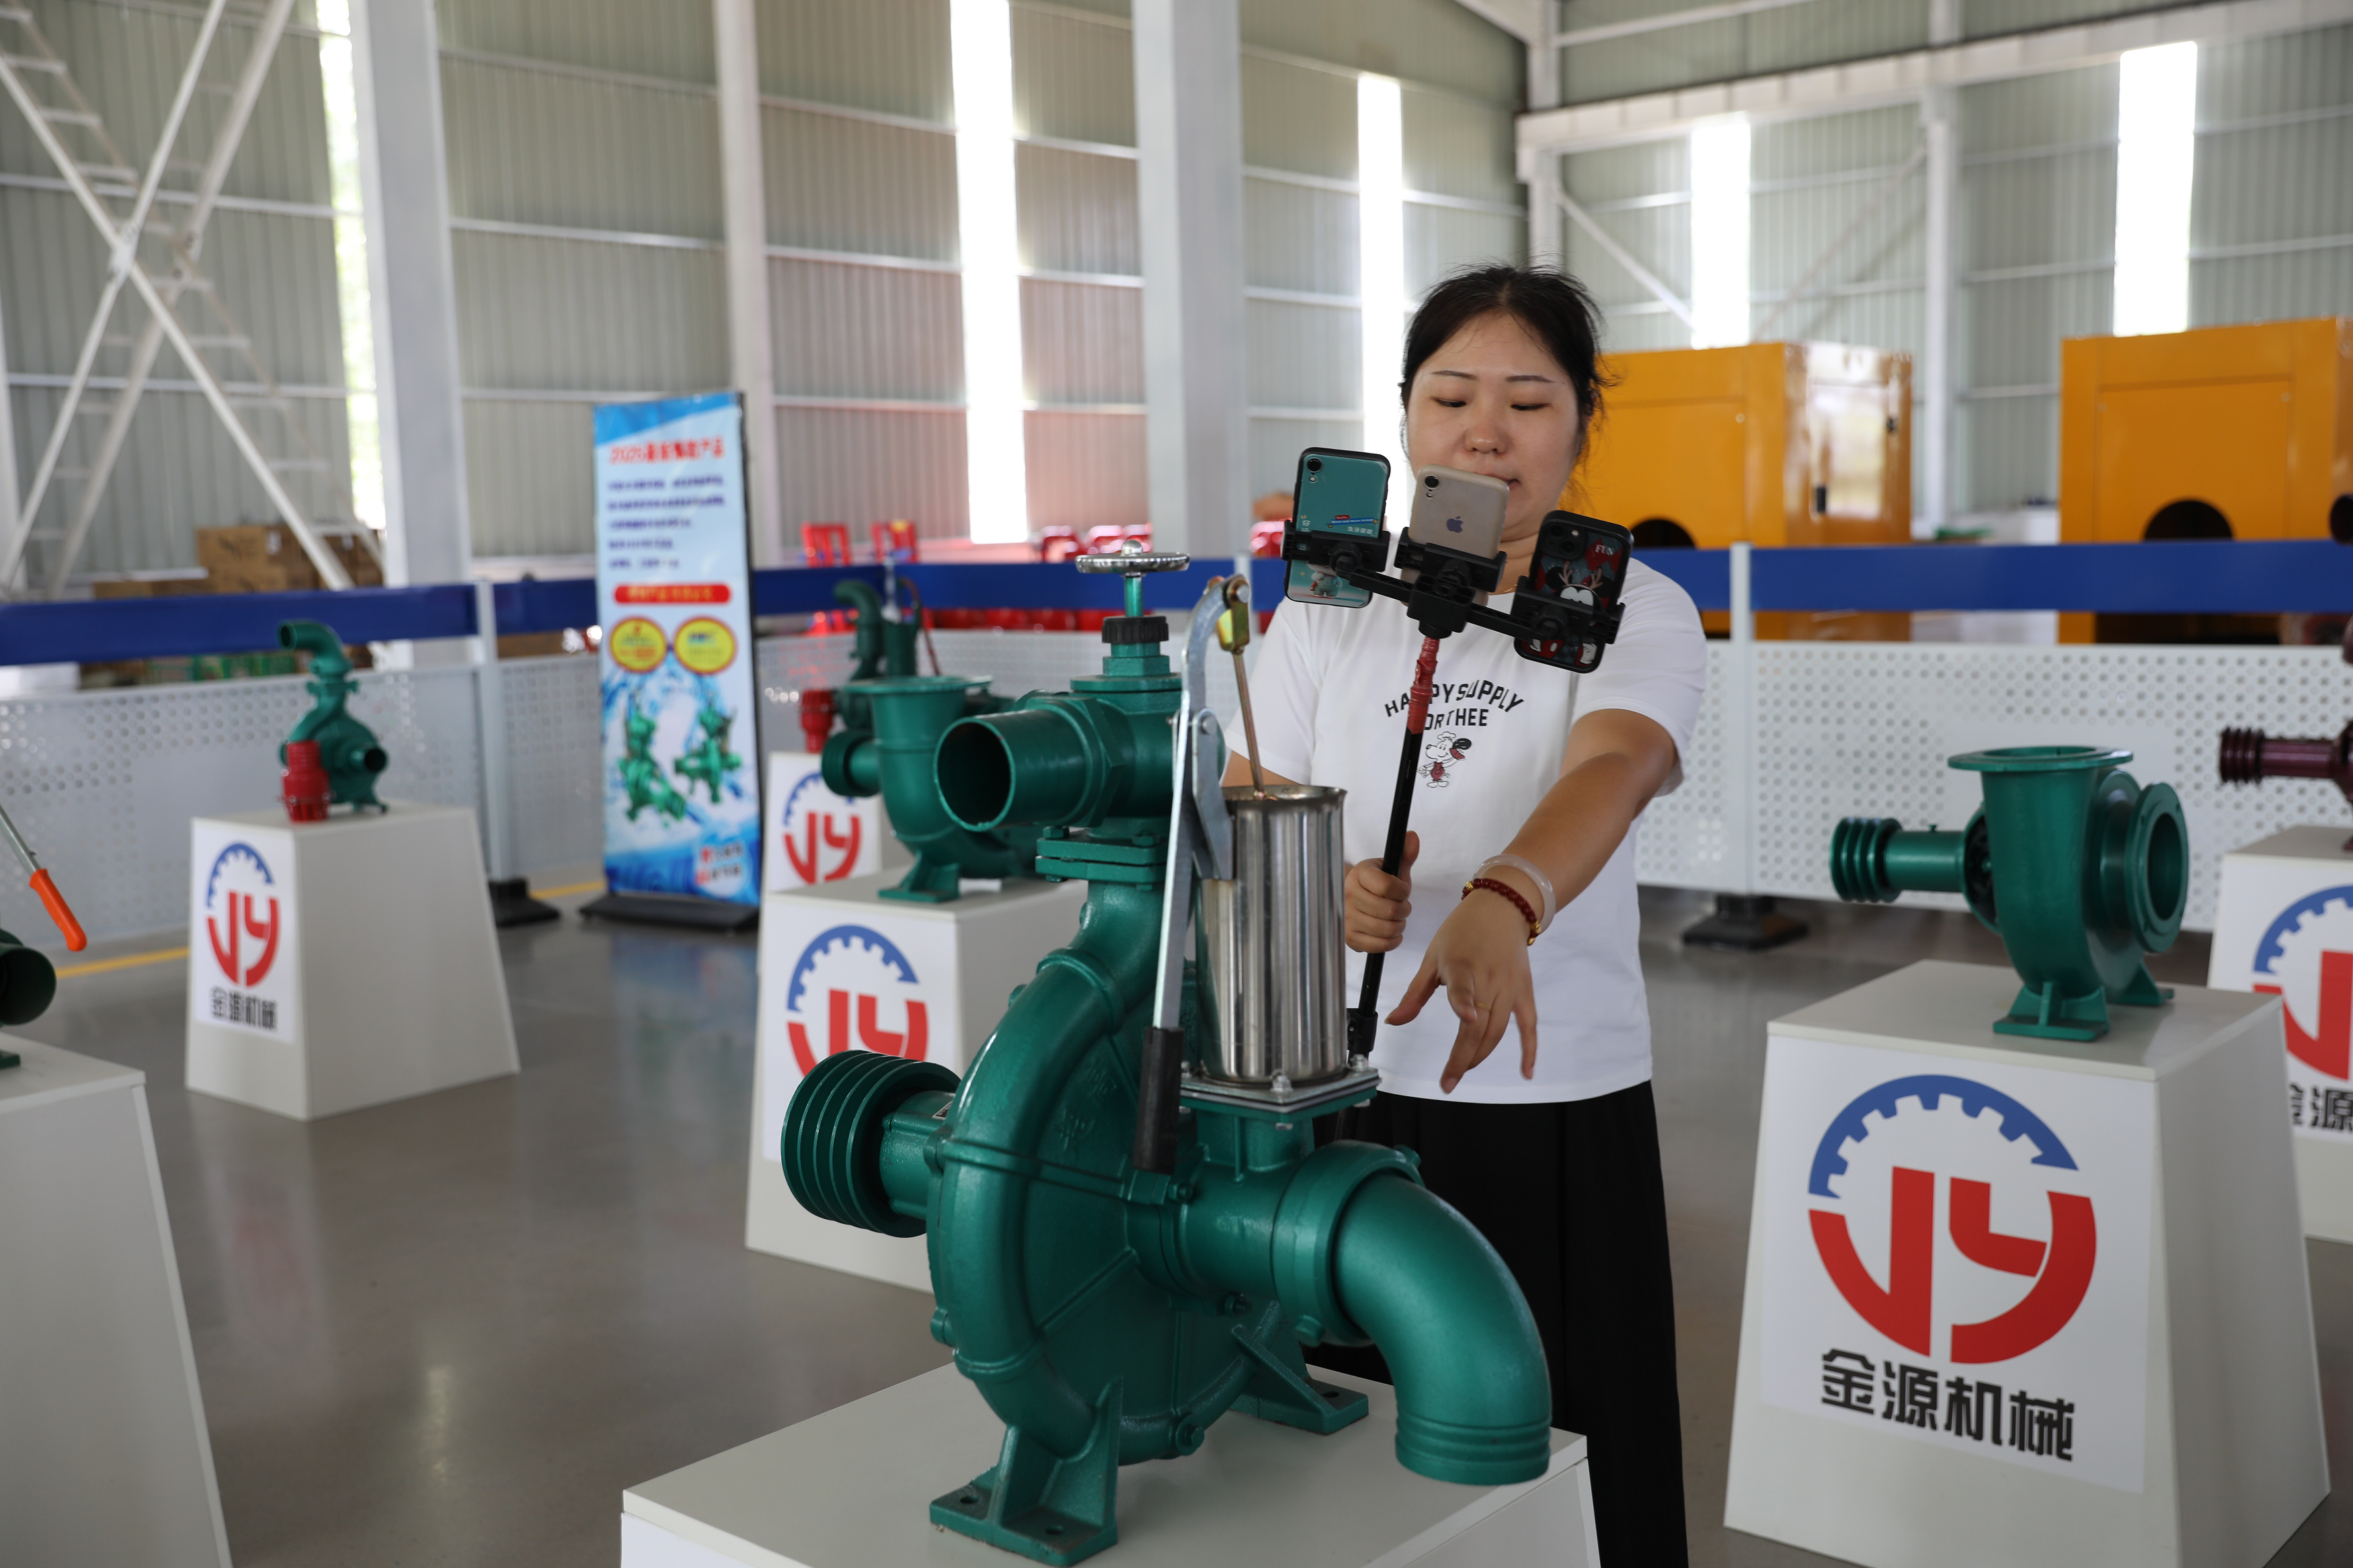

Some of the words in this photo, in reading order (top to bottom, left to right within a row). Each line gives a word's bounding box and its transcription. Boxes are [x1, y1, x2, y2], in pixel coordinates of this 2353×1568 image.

[1595, 544, 1615, 556] FUN
[1384, 684, 1454, 717] HAPY
[1455, 679, 1525, 712] SUPPLY
[1423, 713, 1445, 731] OR
[1445, 708, 1490, 727] THEE
[2288, 1083, 2353, 1132] 源
[1821, 1348, 2075, 1462] 金源机械
